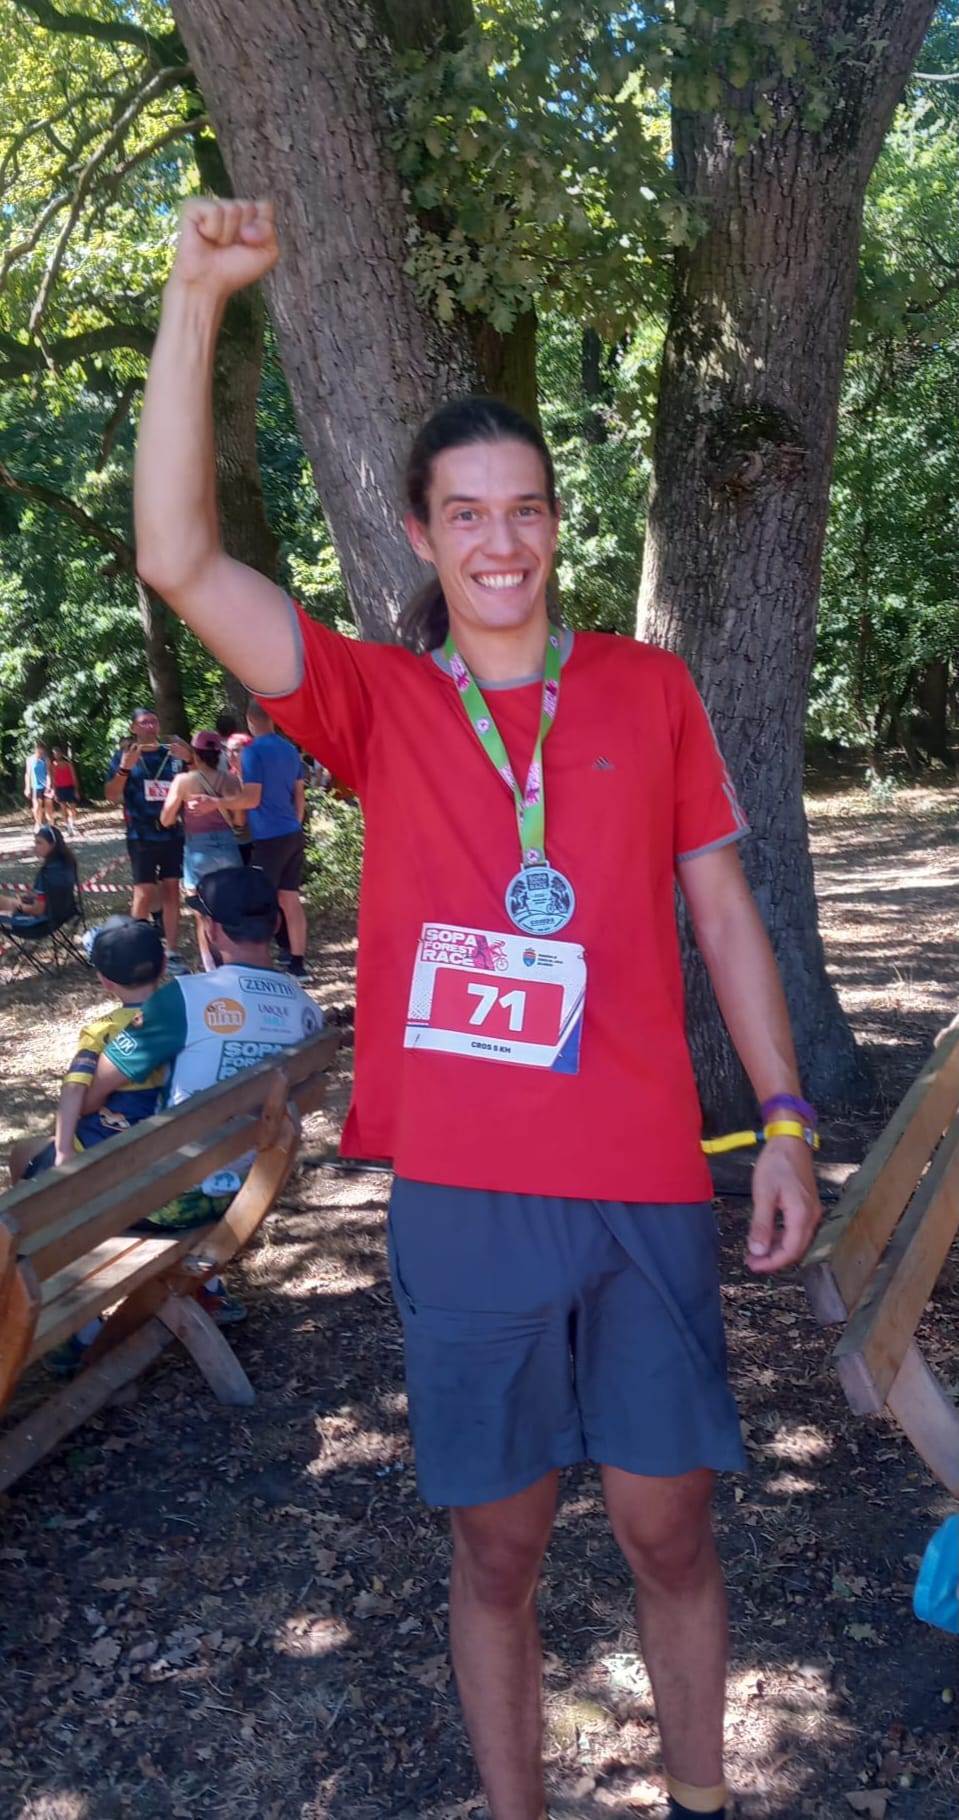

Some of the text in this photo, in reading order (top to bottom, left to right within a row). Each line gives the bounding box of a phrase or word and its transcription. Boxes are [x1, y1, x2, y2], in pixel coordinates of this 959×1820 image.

[426, 928, 477, 947] SOPA
[424, 941, 475, 954] FOREST
[422, 949, 475, 966] RACE
[243, 979, 294, 997] ZENYTH
[467, 982, 526, 1032] 71
[471, 1041, 492, 1050] CROS
